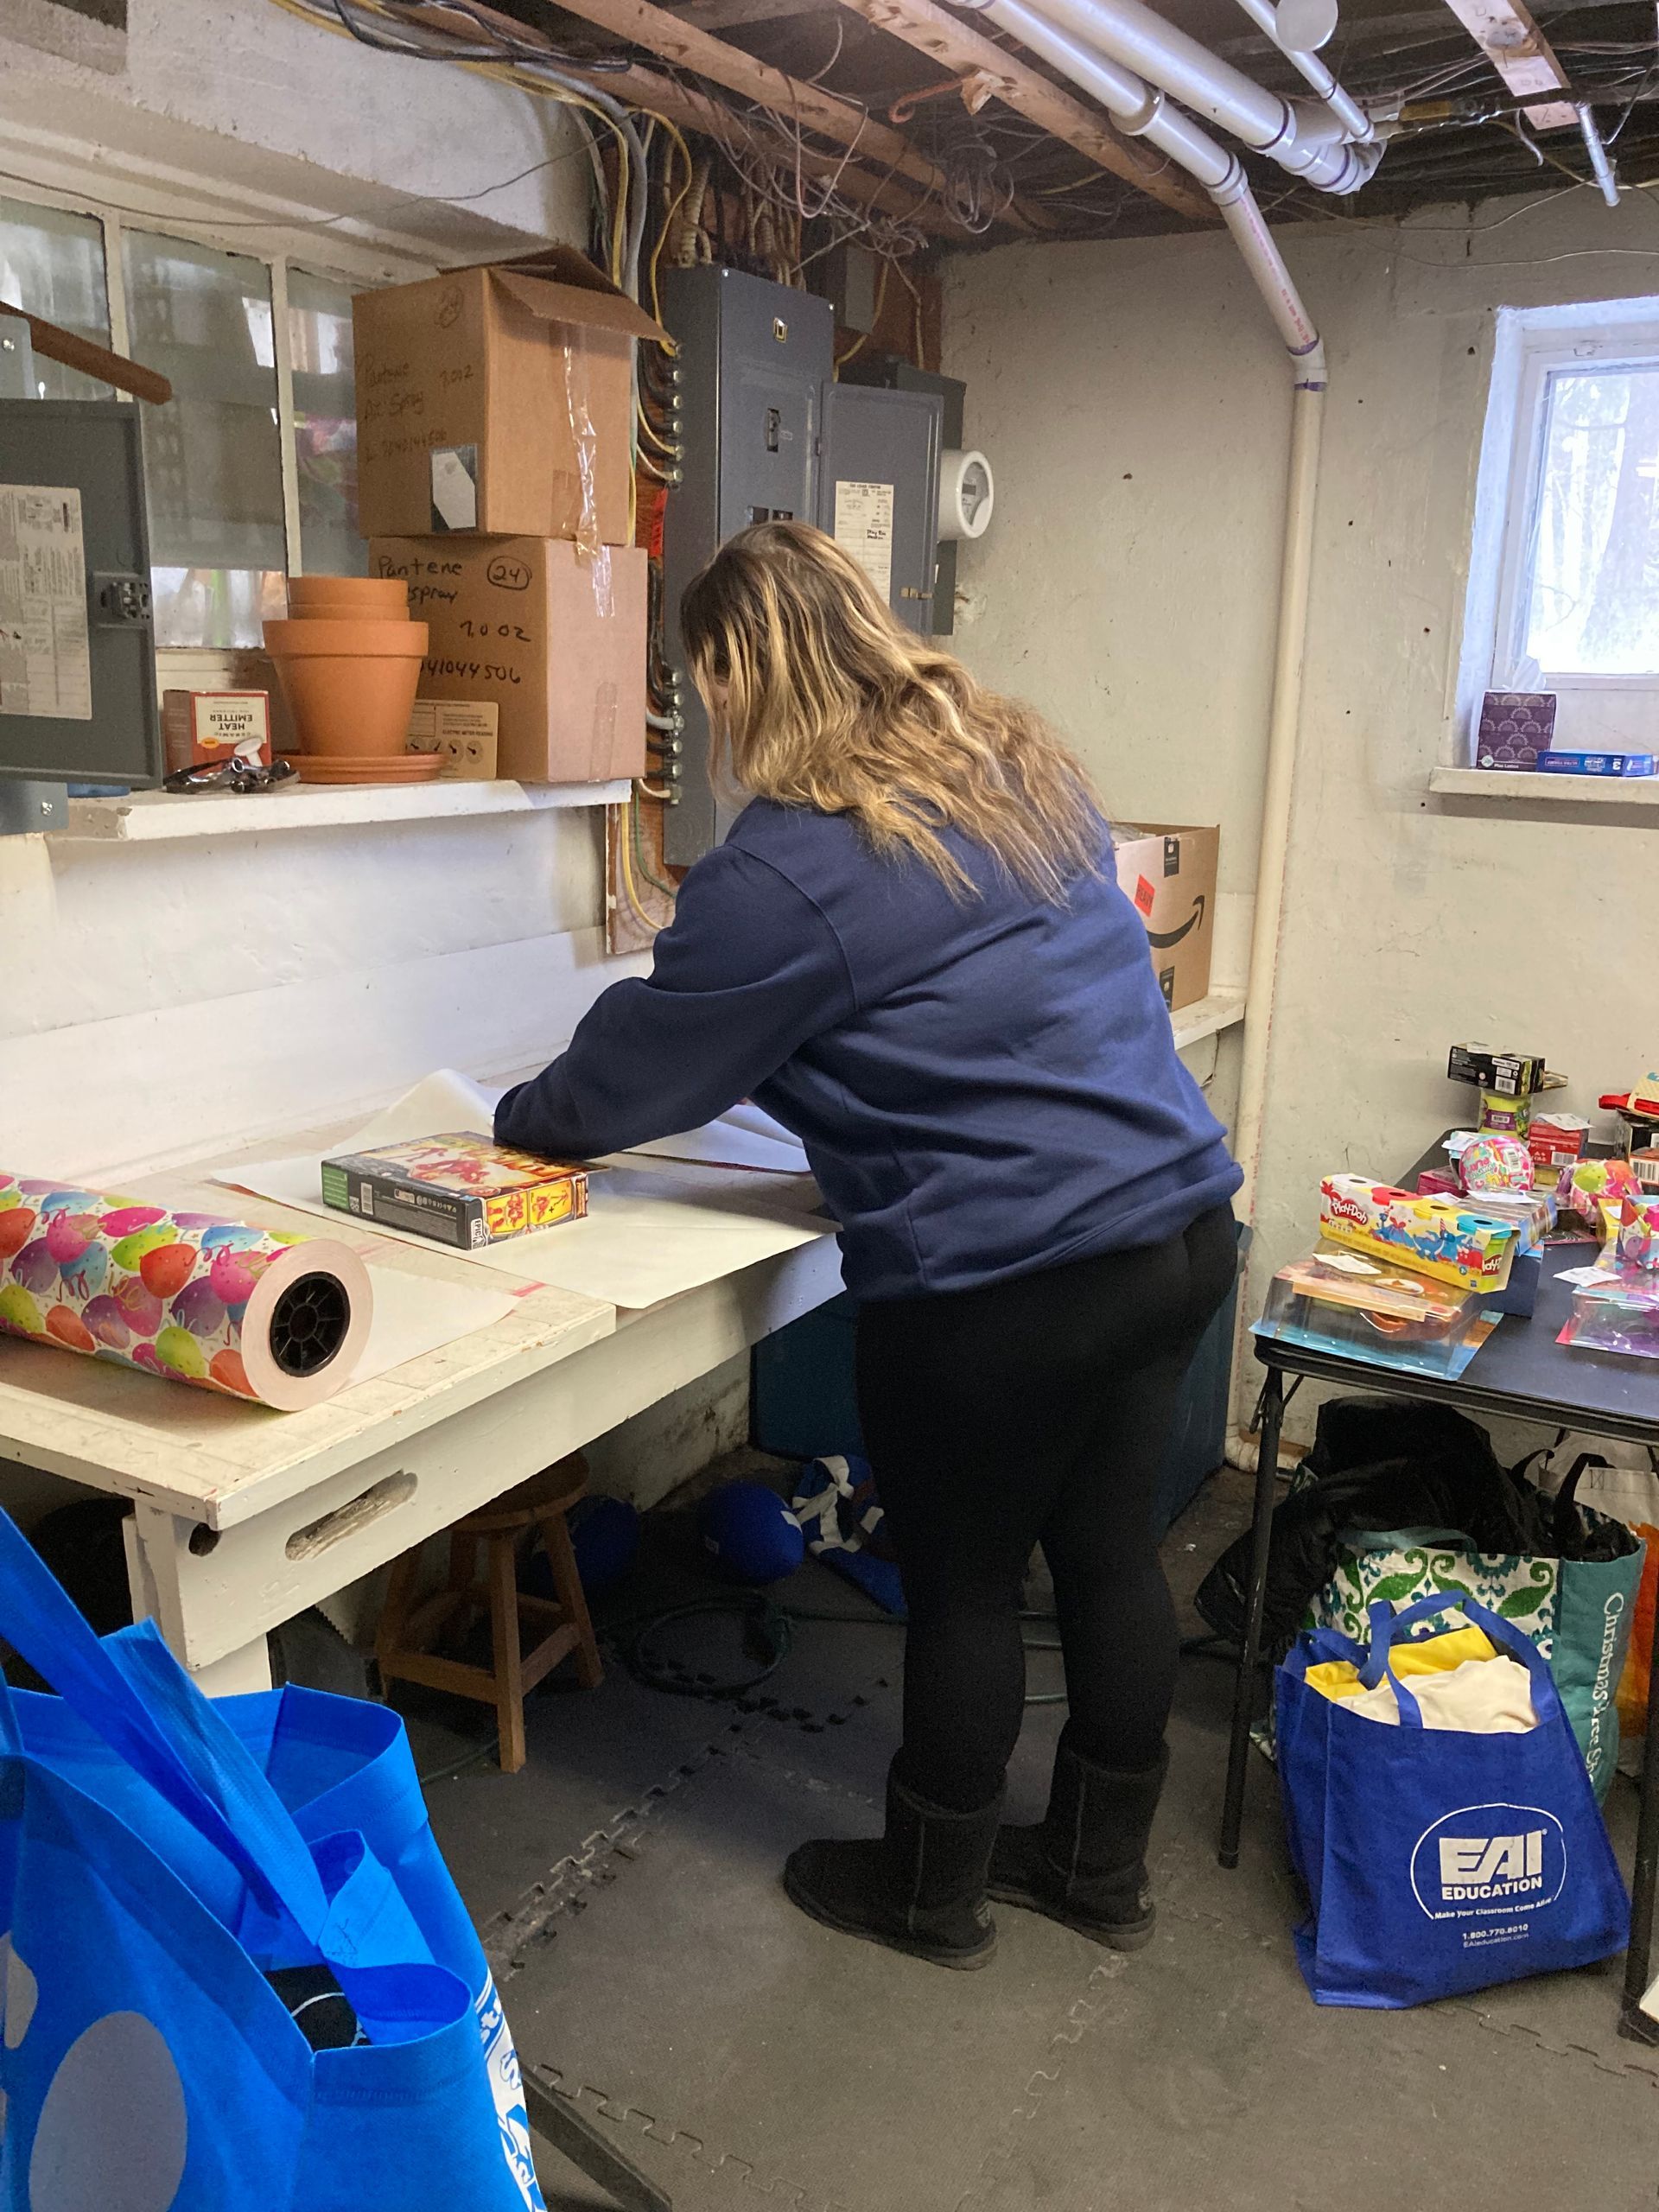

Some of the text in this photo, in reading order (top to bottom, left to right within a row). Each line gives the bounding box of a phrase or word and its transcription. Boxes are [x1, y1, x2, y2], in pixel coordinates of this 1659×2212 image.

[378, 556, 462, 579] Pantene
[493, 565, 520, 582] 24
[209, 714, 253, 722] EMITTER
[219, 722, 245, 731] HEAT
[1612, 760, 1621, 771] 3
[1592, 1592, 1624, 1701] Christmas
[1439, 1829, 1542, 1885] EAI
[1441, 1876, 1543, 1901] EDUCATION
[1434, 1897, 1553, 1920] Make Your Classroom Come Alive
[1462, 1923, 1529, 1941] 1.800.770.8010
